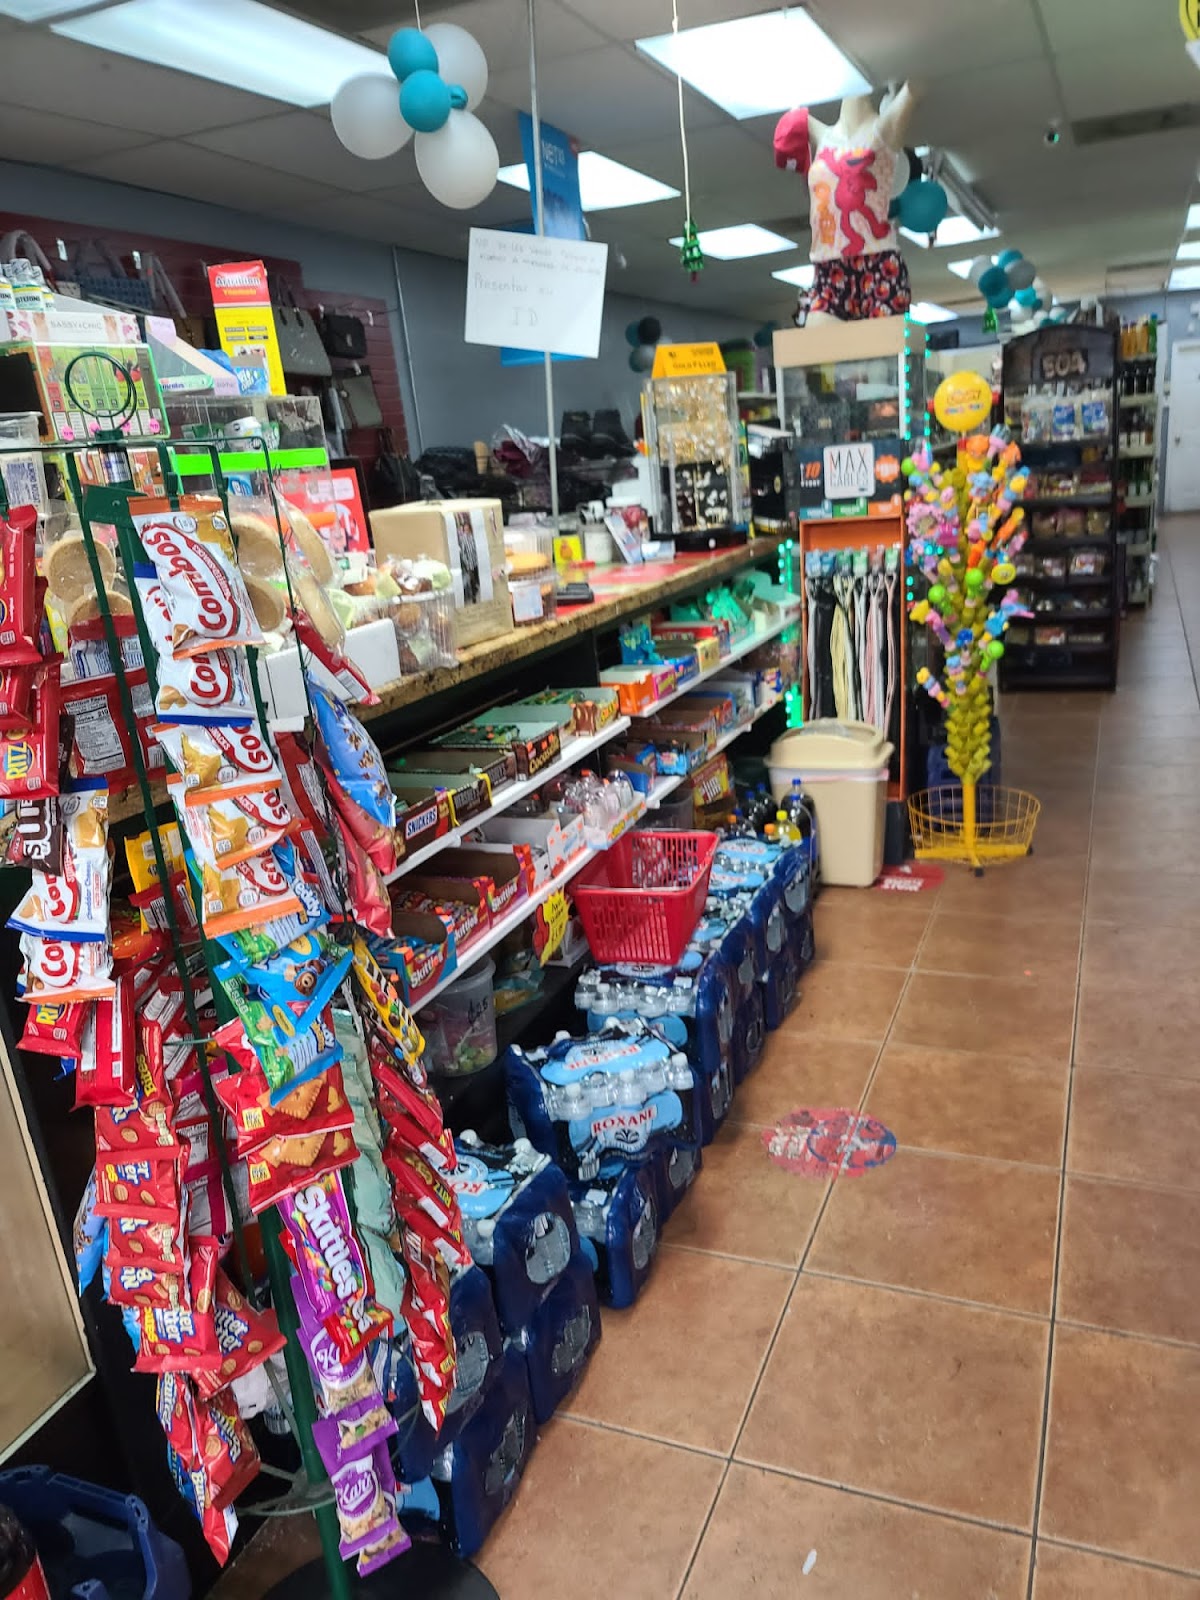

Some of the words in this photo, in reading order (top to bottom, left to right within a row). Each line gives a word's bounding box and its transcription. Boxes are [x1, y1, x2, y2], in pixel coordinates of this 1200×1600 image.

[829, 447, 869, 473] MAX
[5, 741, 28, 781] RITZ
[406, 806, 438, 838] SNICKERS
[490, 880, 518, 912] Skittles
[409, 951, 446, 990] Skittls
[294, 1185, 357, 1299] Skittles
